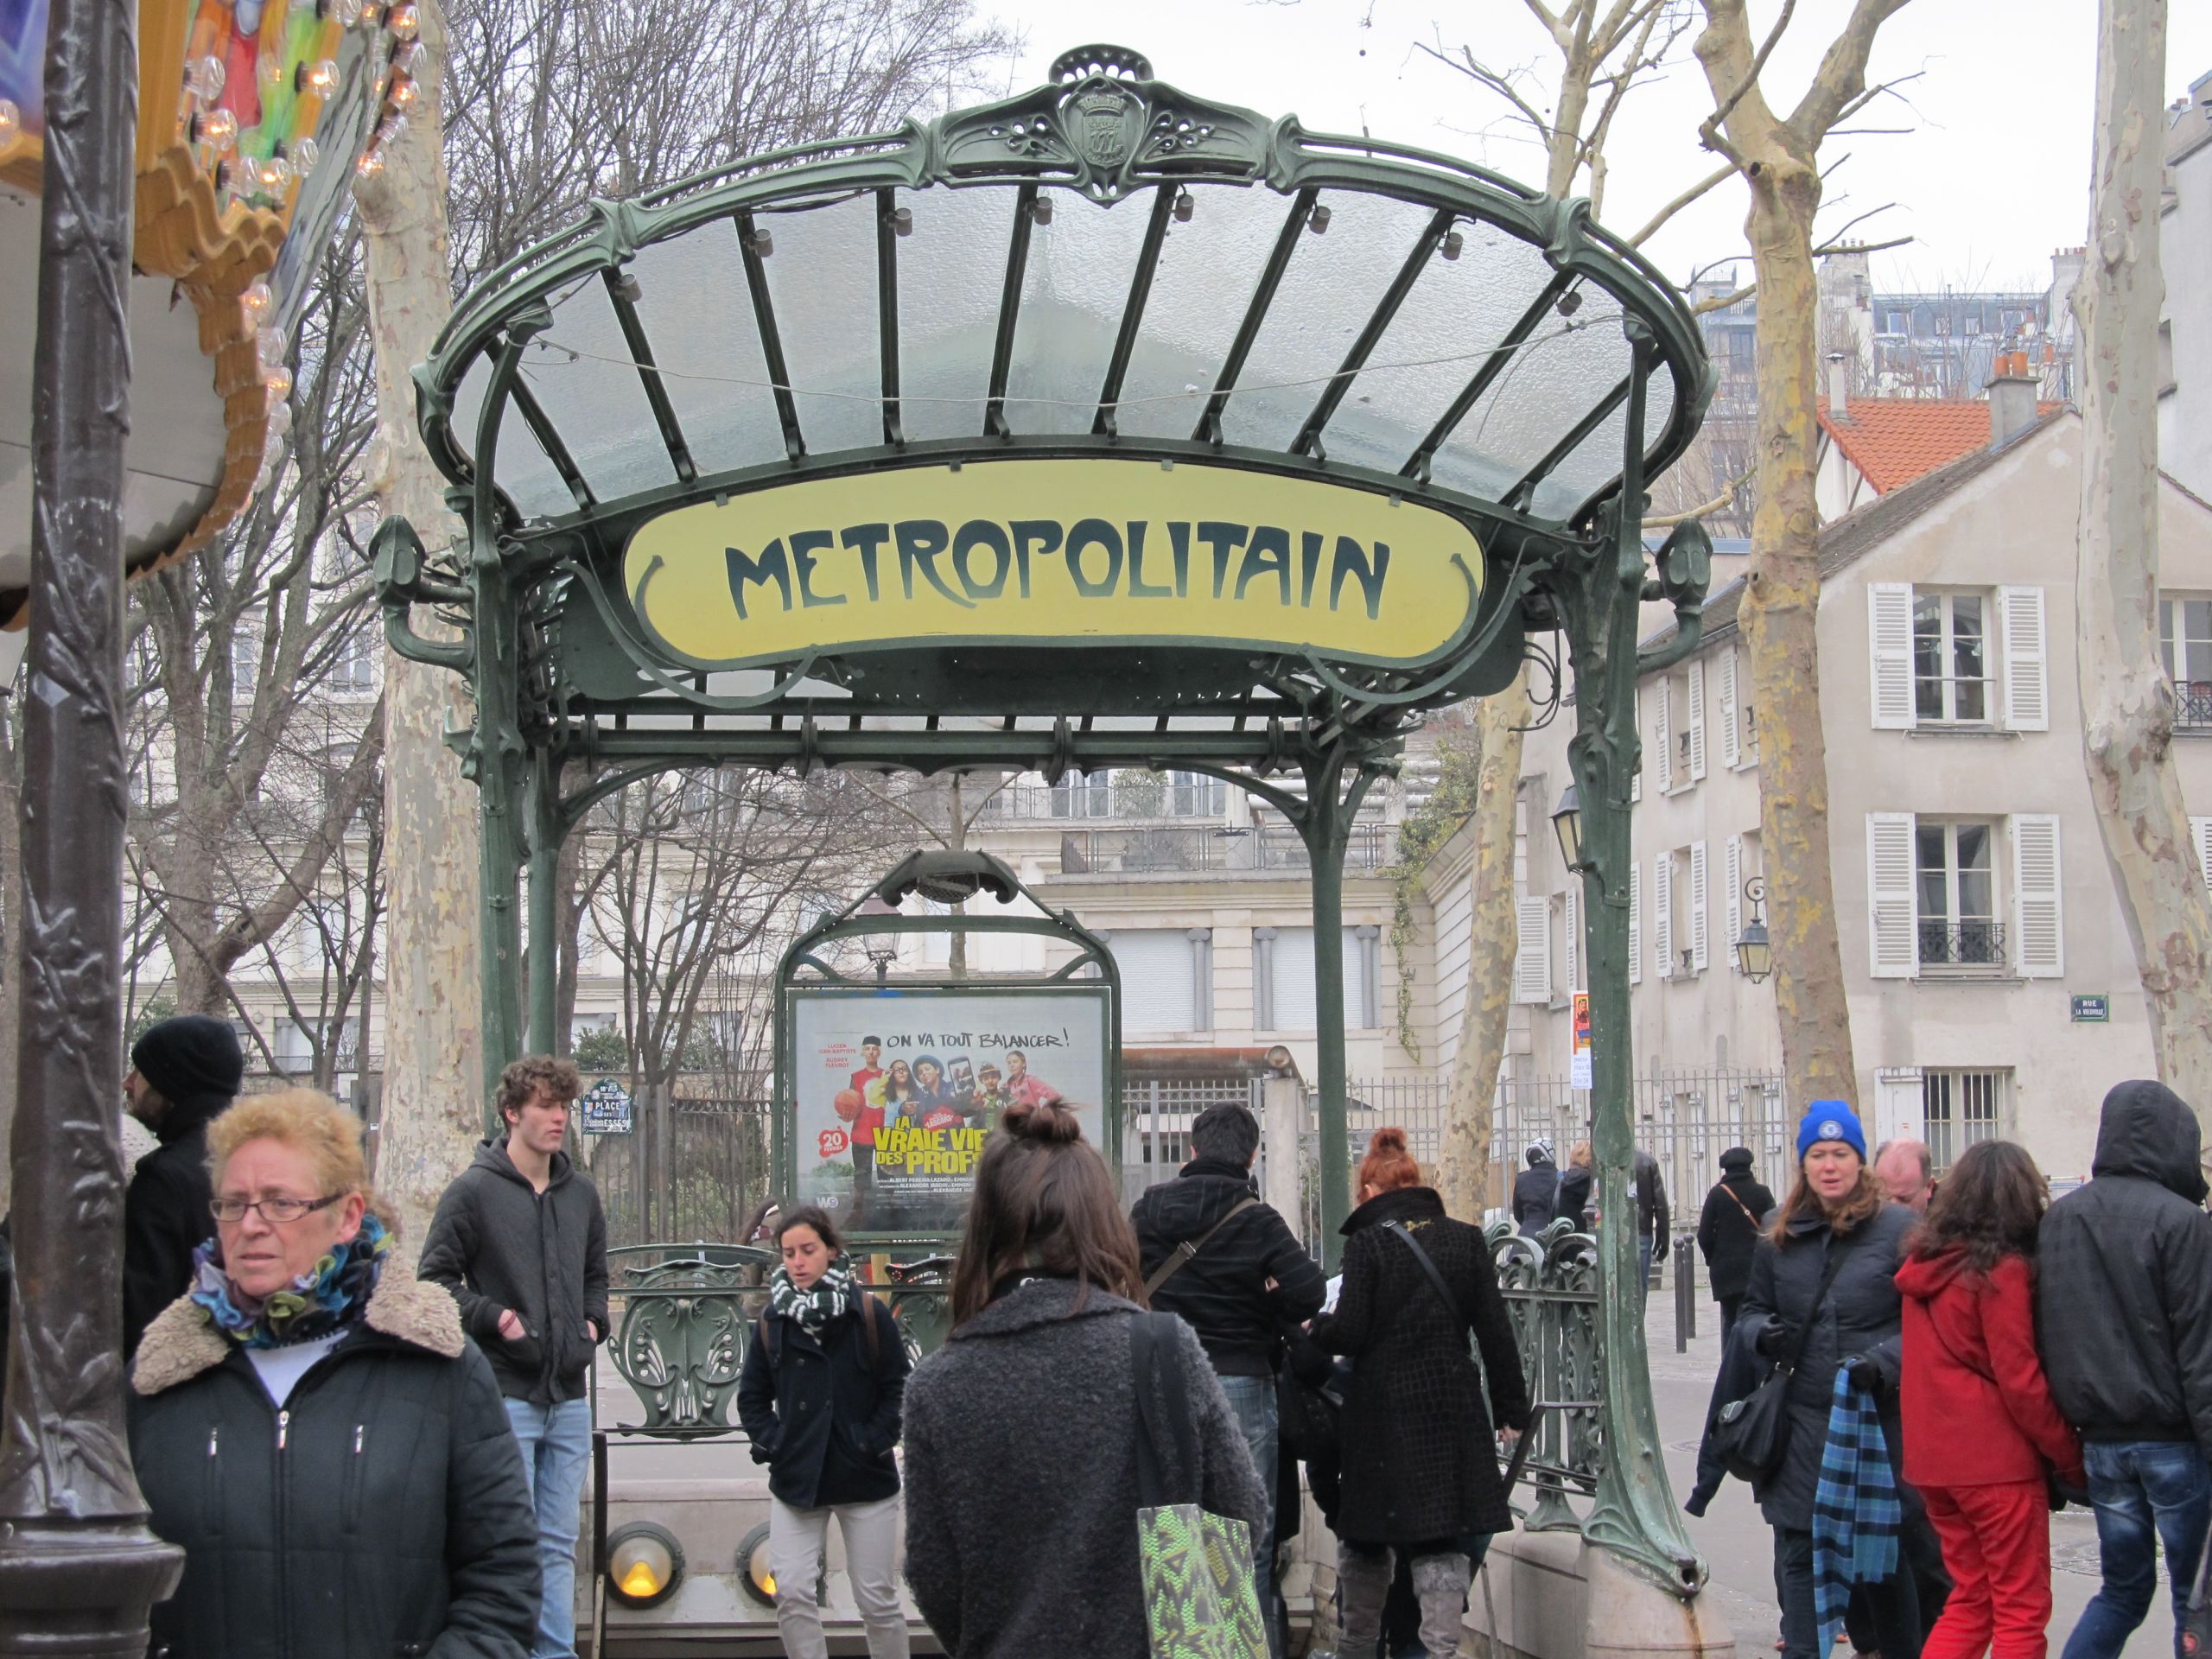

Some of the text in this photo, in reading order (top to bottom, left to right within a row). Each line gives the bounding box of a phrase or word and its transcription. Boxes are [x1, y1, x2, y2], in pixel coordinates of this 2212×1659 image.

[724, 518, 1390, 620] METROPOLITAIN
[887, 1034, 912, 1048] ON
[918, 1033, 935, 1047] VA
[940, 1032, 973, 1047] TOUT
[595, 1102, 620, 1110] PLACE
[893, 1116, 912, 1130] LA
[823, 1132, 842, 1147] 20
[873, 1127, 946, 1153] VRAIE
[876, 1151, 904, 1165] DES
[816, 1196, 838, 1208] W9
